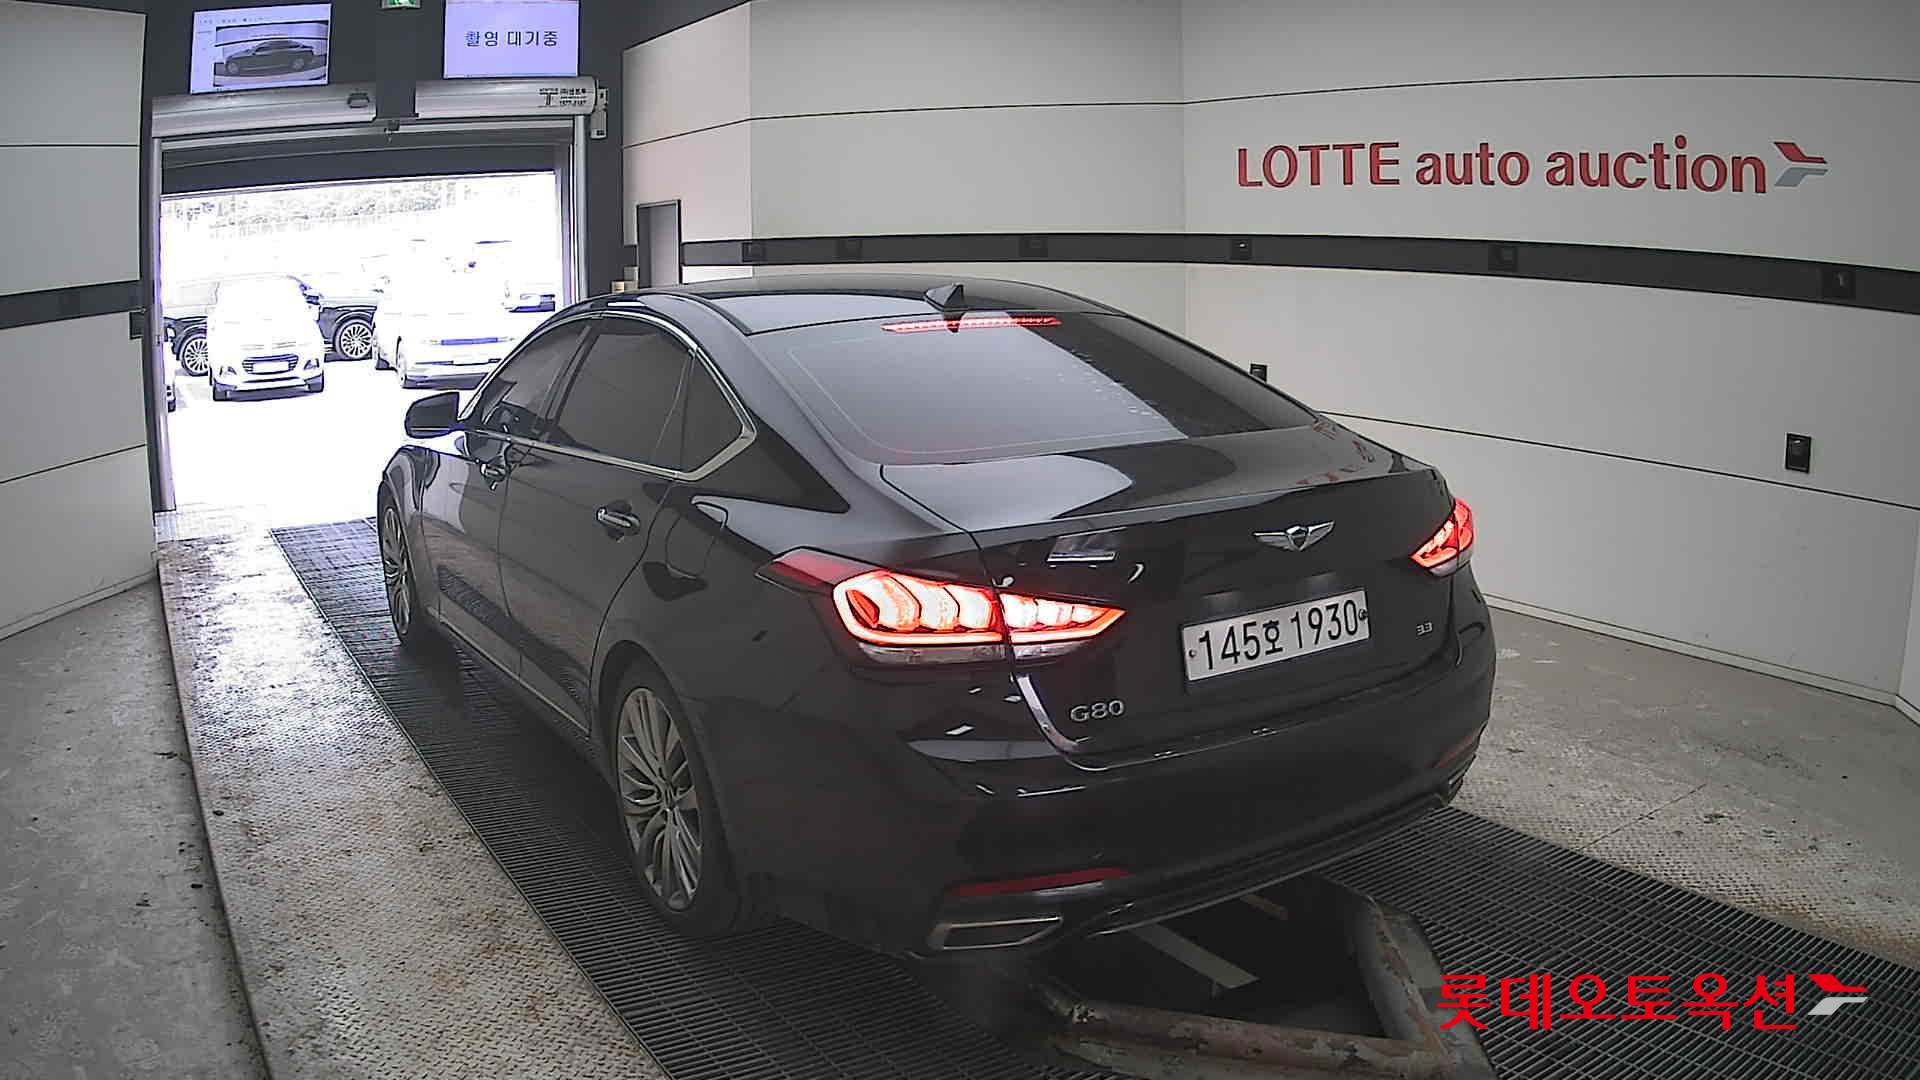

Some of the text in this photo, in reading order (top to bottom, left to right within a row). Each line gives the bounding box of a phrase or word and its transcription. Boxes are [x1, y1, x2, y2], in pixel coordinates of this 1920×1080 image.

[507, 31, 558, 47] 대기중
[1238, 136, 1767, 194] LOTTE auto auction
[1198, 599, 1358, 670] 145호 1930
[1070, 700, 1124, 722] G80
